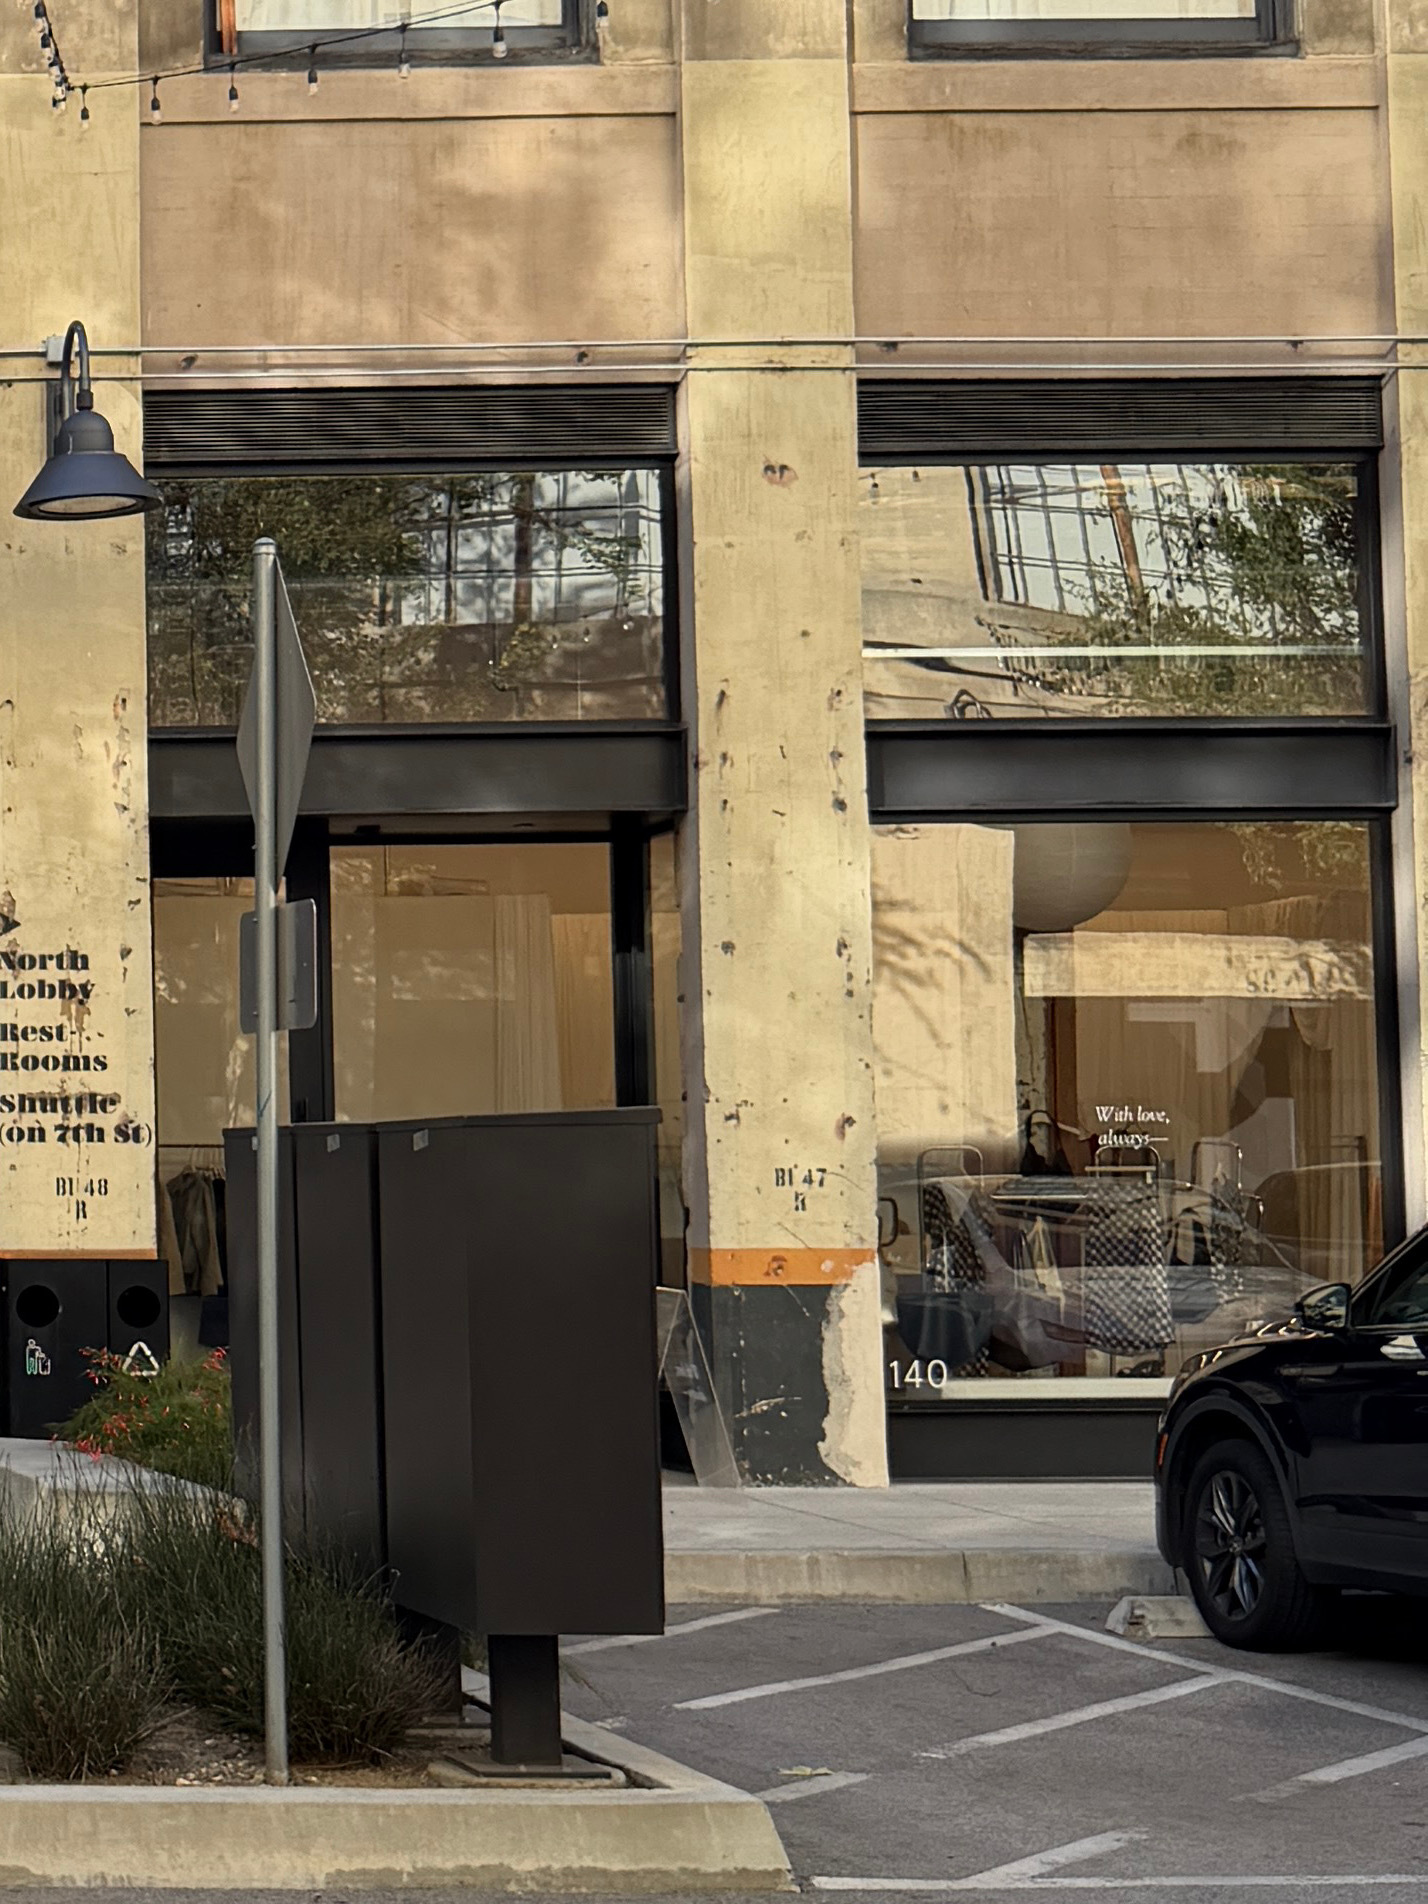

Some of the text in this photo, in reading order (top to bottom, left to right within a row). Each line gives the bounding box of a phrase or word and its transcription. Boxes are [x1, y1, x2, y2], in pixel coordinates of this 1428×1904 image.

[1095, 1105, 1171, 1124] With love,
[54, 1123, 105, 1144] 7th
[114, 1123, 153, 1147] St)
[889, 1359, 948, 1389] 140
